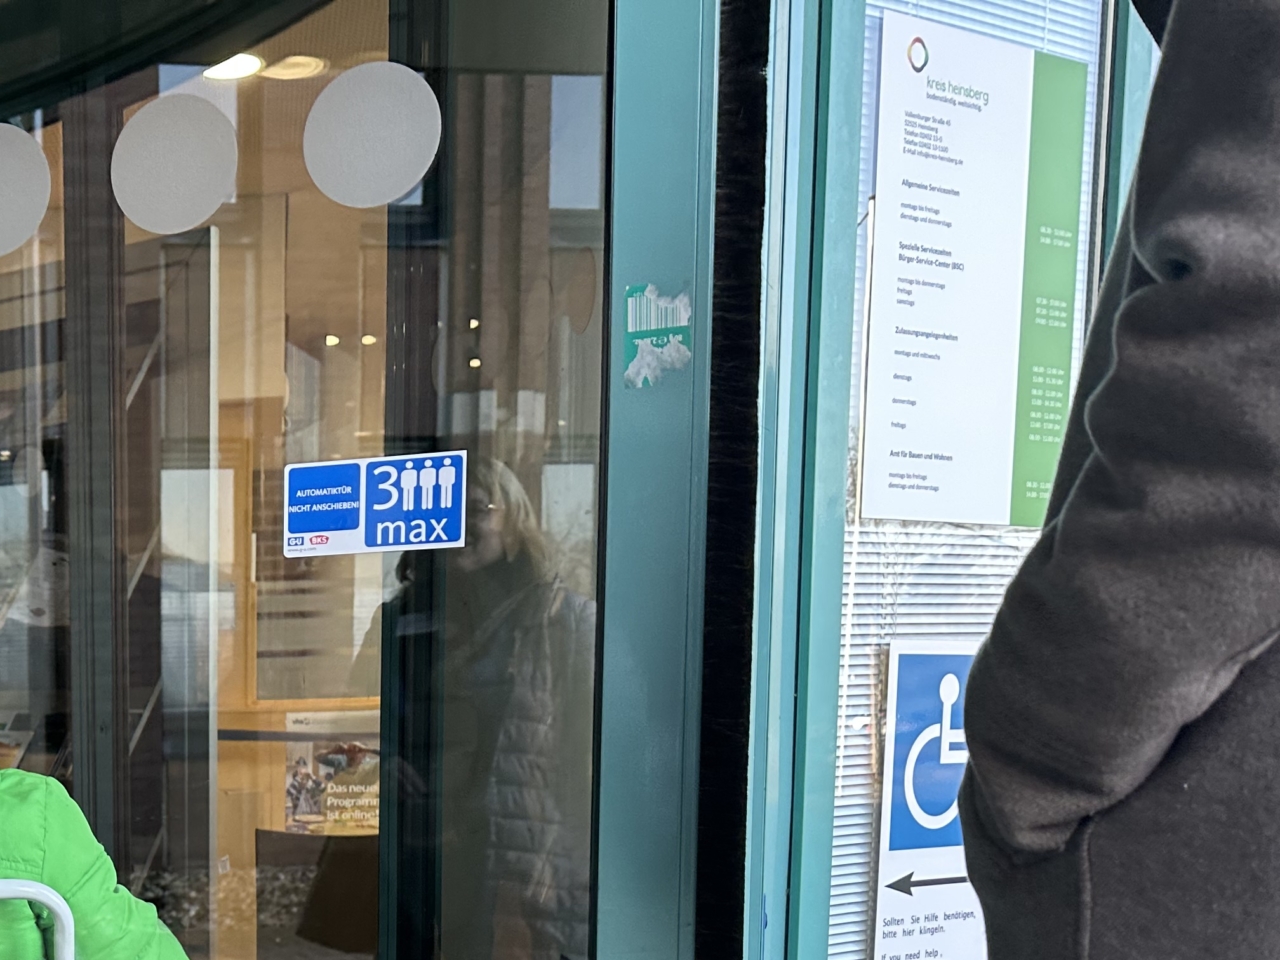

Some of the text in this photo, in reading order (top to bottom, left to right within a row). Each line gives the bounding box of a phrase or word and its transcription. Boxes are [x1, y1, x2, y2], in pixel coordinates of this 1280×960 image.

[926, 75, 989, 106] kreis heinsberg
[899, 241, 920, 252] Spezielle
[889, 449, 900, 457] Amt
[908, 451, 923, 459] Bauen
[296, 485, 352, 498] AUTOMATIKTÜR
[372, 465, 399, 511] 3
[289, 501, 359, 513] NICHT ANSCHIEBEN!
[376, 518, 448, 545] max
[327, 783, 347, 793] Das
[882, 917, 904, 927] Sollten
[910, 914, 920, 924] Sie
[924, 912, 939, 923] Hilfe
[882, 924, 945, 939] bitte hier klingeln.
[905, 950, 920, 960] need
